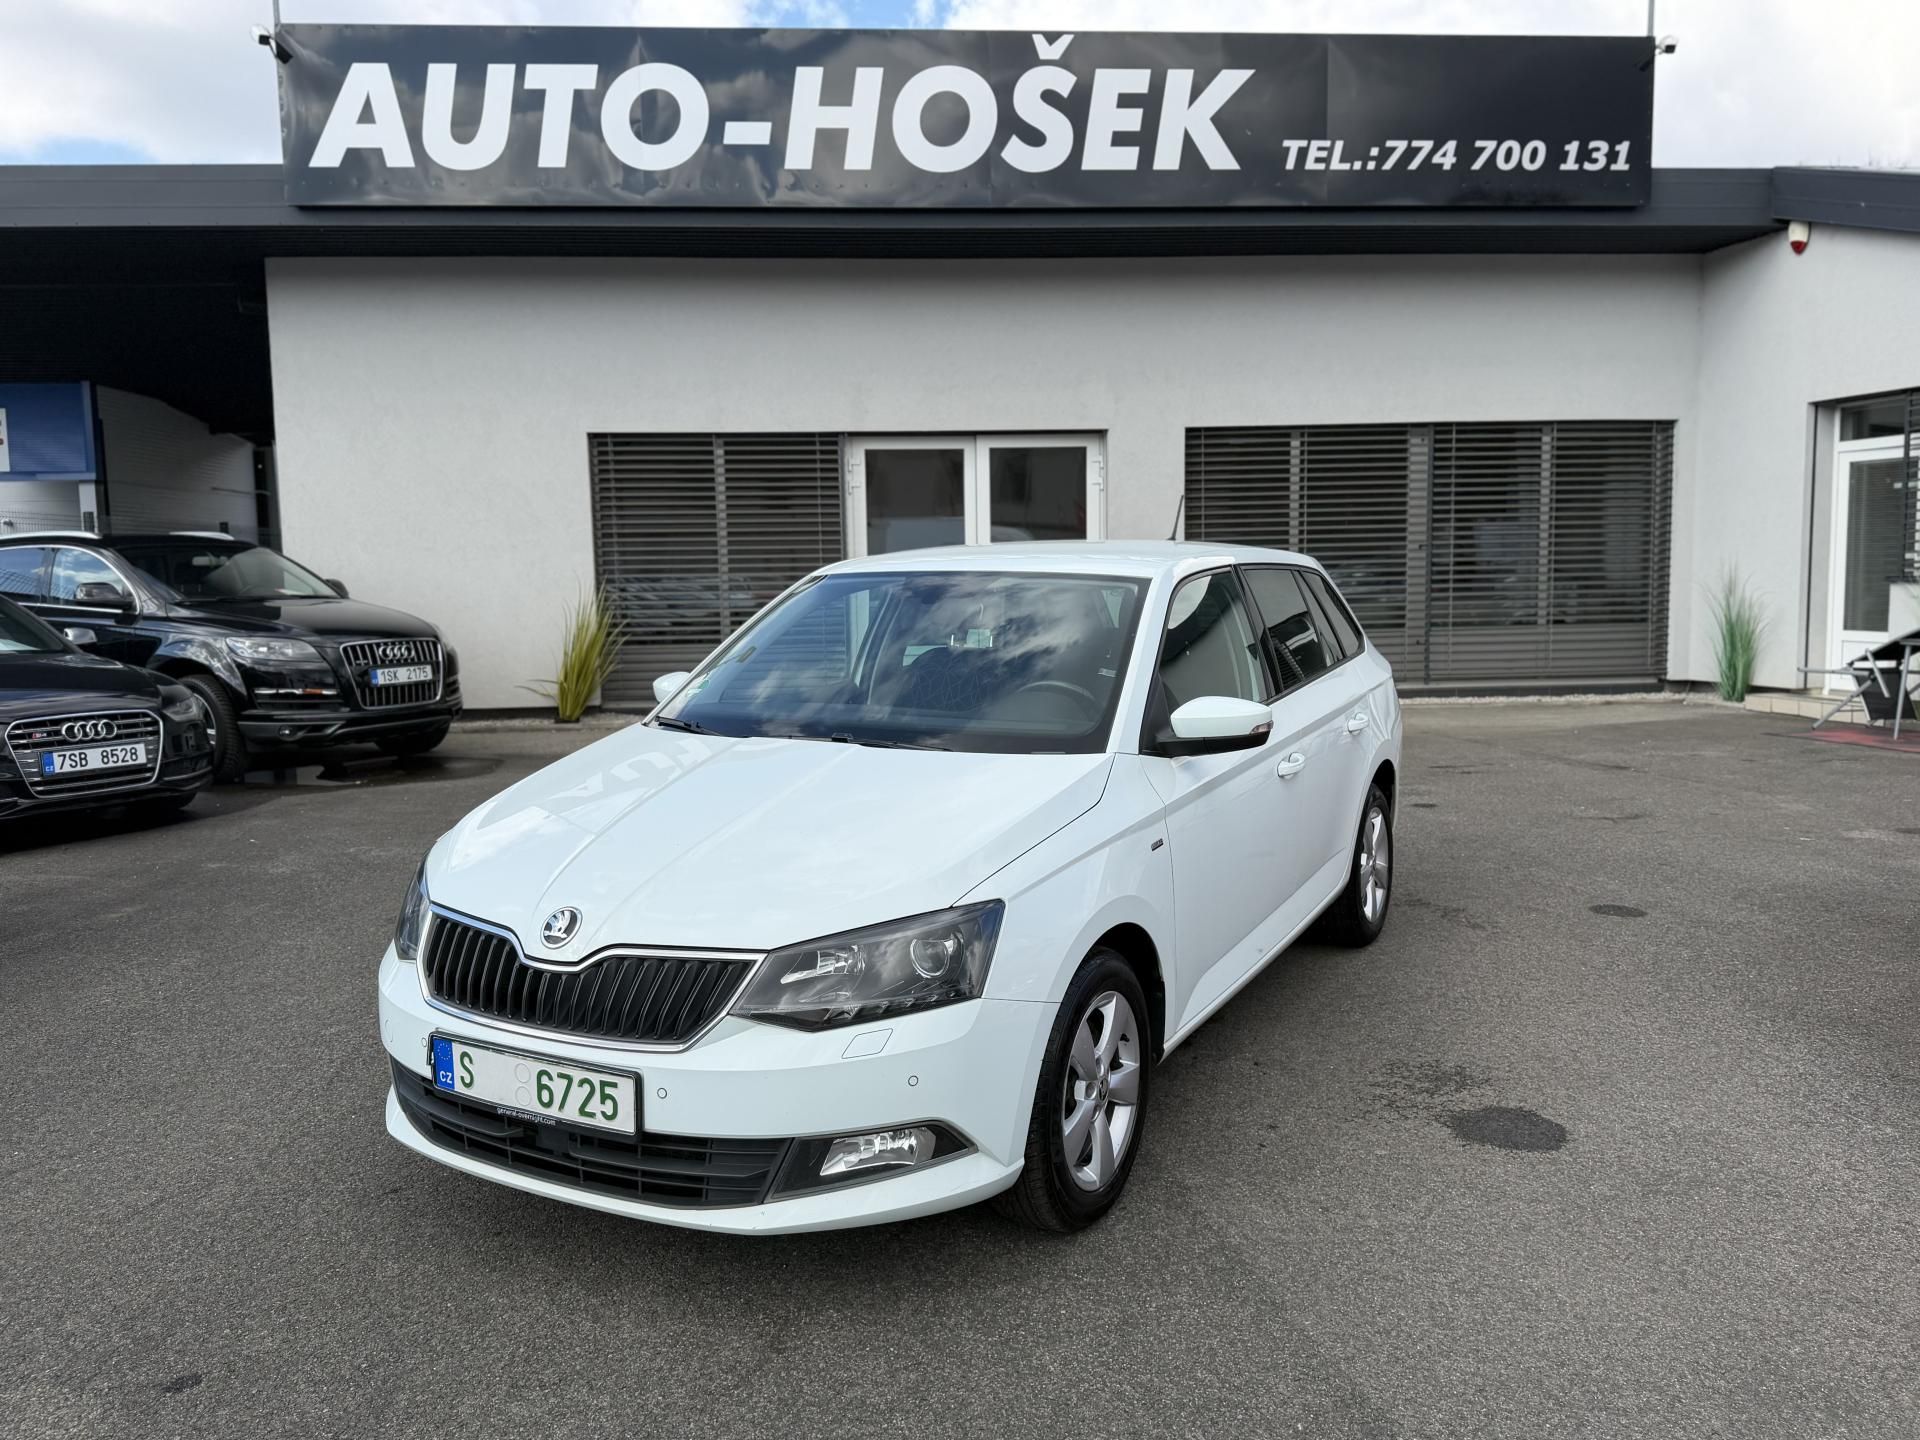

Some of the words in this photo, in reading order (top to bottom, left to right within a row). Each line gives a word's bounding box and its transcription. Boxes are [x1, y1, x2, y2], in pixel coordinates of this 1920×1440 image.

[308, 33, 1256, 173] AUTO-HOŠEK
[1281, 138, 1457, 172] TEL.:774
[1472, 138, 1547, 172] 700
[1558, 139, 1631, 172] 131
[380, 669, 400, 683] 1SK
[406, 666, 429, 680] 2175
[57, 751, 89, 770] 7SB
[100, 747, 139, 765] 8528
[439, 1070, 453, 1084] CZ
[459, 1051, 475, 1089] S
[536, 1069, 619, 1121] 6725
